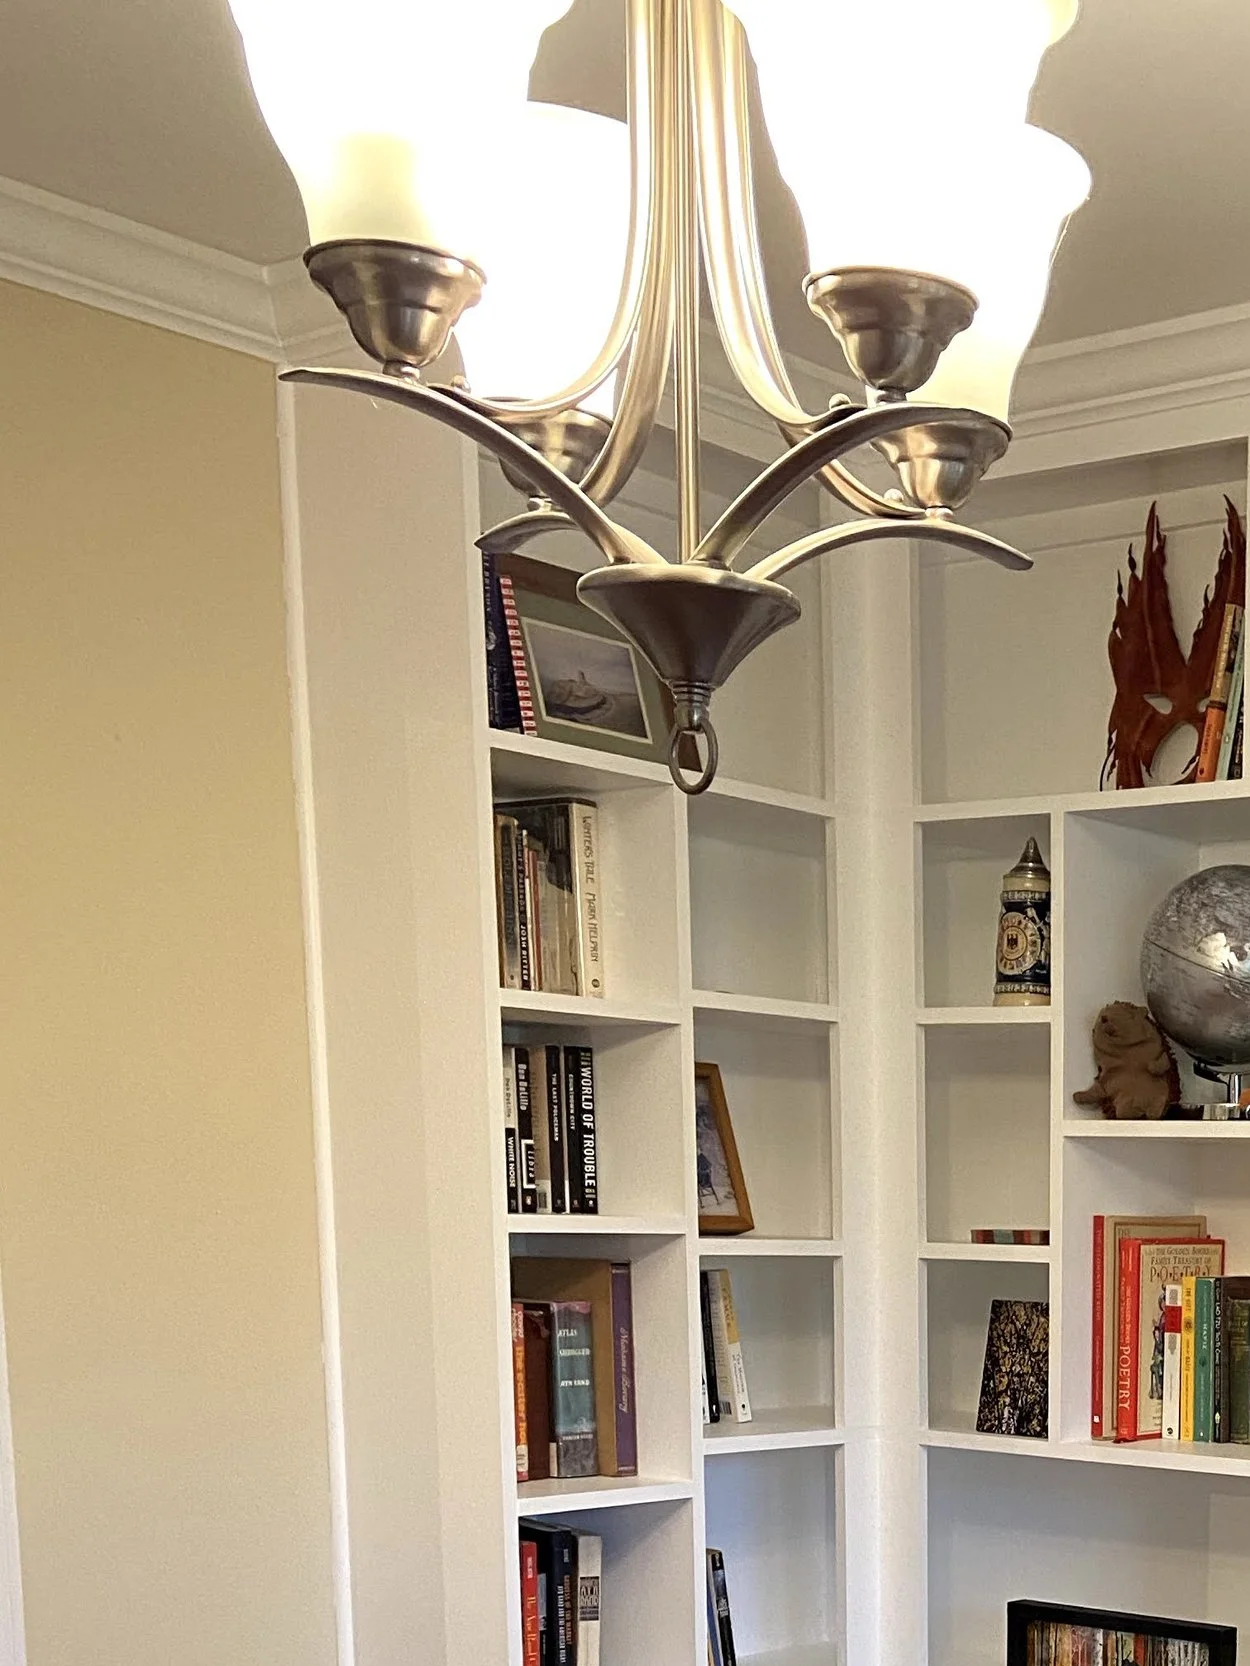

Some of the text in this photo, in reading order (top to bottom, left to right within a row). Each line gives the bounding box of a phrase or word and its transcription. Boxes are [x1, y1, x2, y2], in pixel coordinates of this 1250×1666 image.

[581, 1067, 595, 1187] WORLD OF TROUBLE
[1119, 1345, 1130, 1410] POETRY
